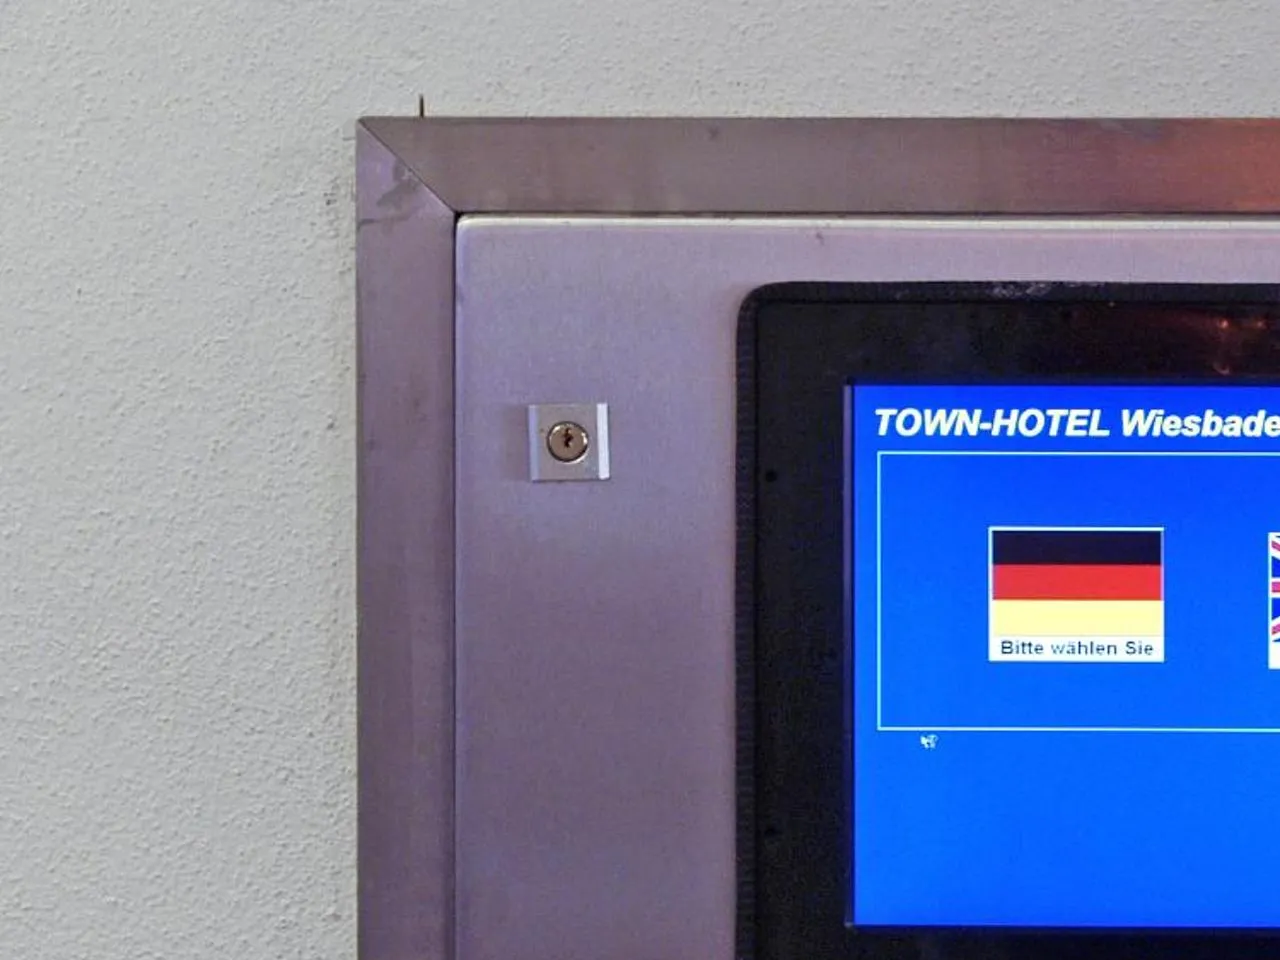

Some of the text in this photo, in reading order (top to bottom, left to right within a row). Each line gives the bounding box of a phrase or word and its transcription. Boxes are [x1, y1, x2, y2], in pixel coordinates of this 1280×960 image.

[875, 408, 1110, 437] TOWN-HOTEL
[1001, 640, 1154, 656] Bitte wählen Sie
